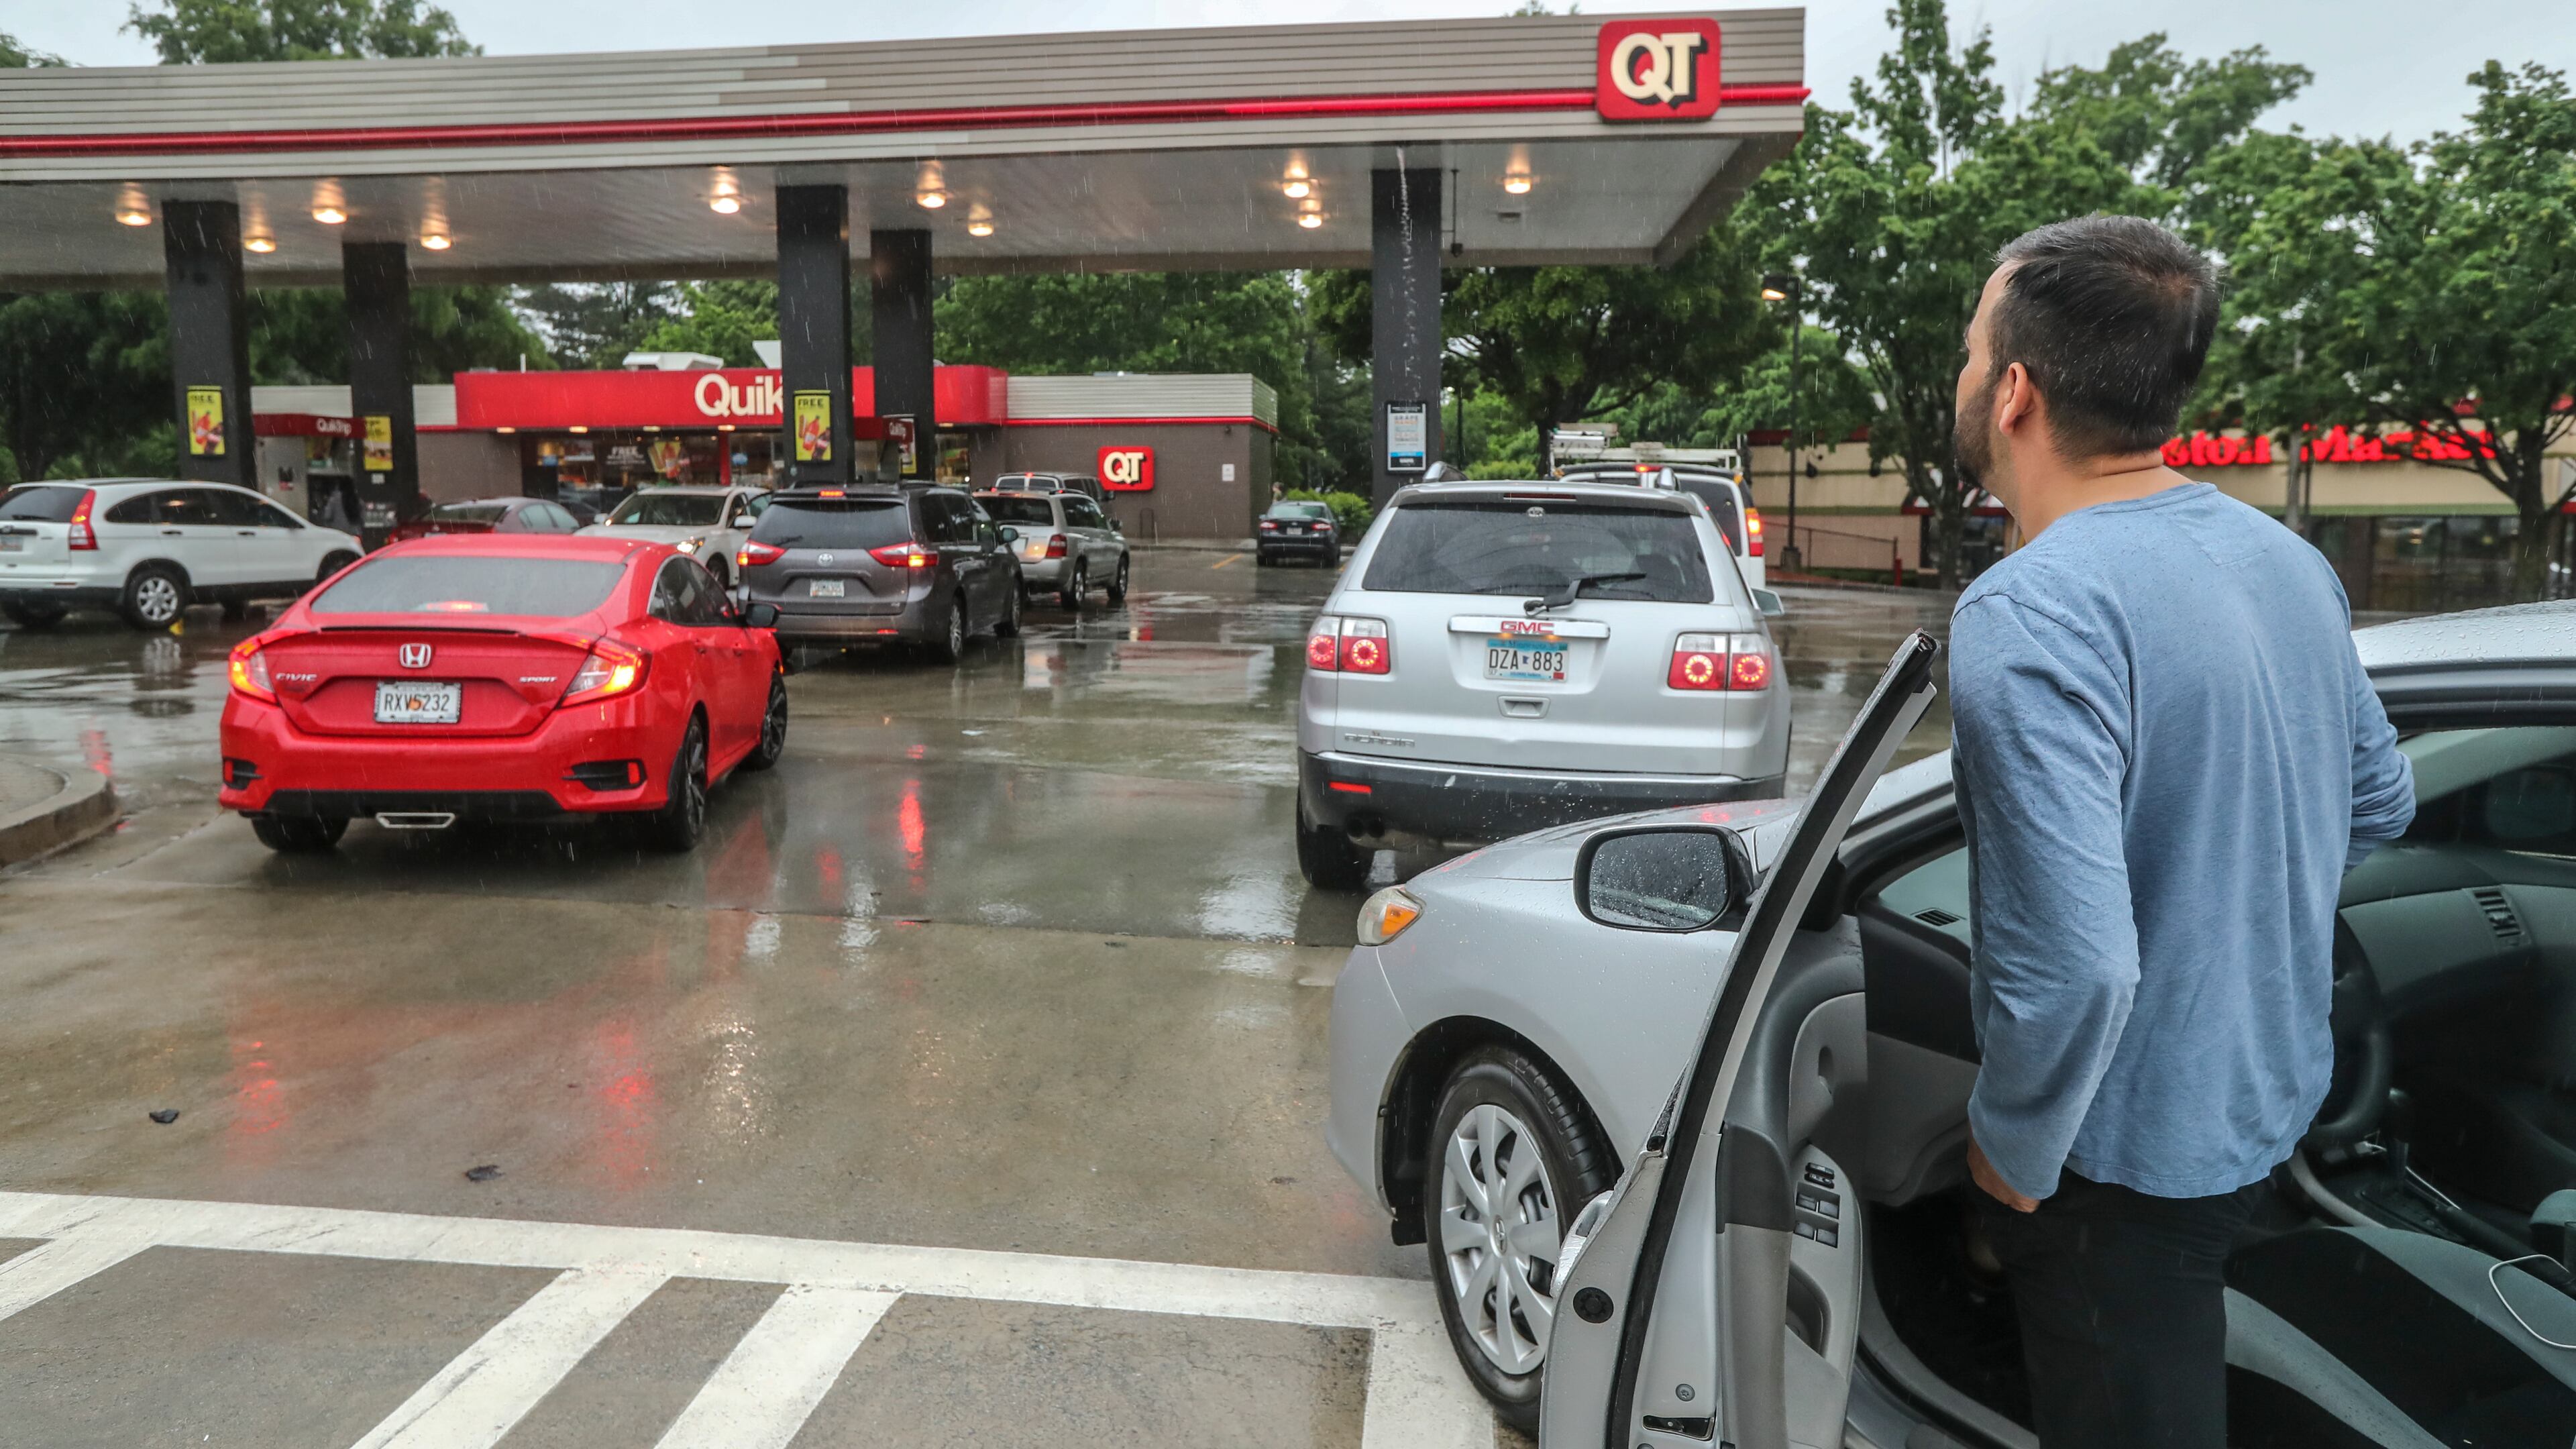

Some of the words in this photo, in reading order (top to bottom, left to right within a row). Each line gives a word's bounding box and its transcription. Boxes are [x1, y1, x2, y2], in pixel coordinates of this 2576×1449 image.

[1611, 32, 1701, 103] QT
[694, 373, 783, 417] Quik
[2159, 429, 2272, 467] ston
[1103, 451, 1144, 484] QT
[1500, 621, 1554, 635] GMC
[1489, 648, 1519, 670] DZA
[1532, 651, 1563, 672] 883
[384, 694, 450, 712] RXV5232
